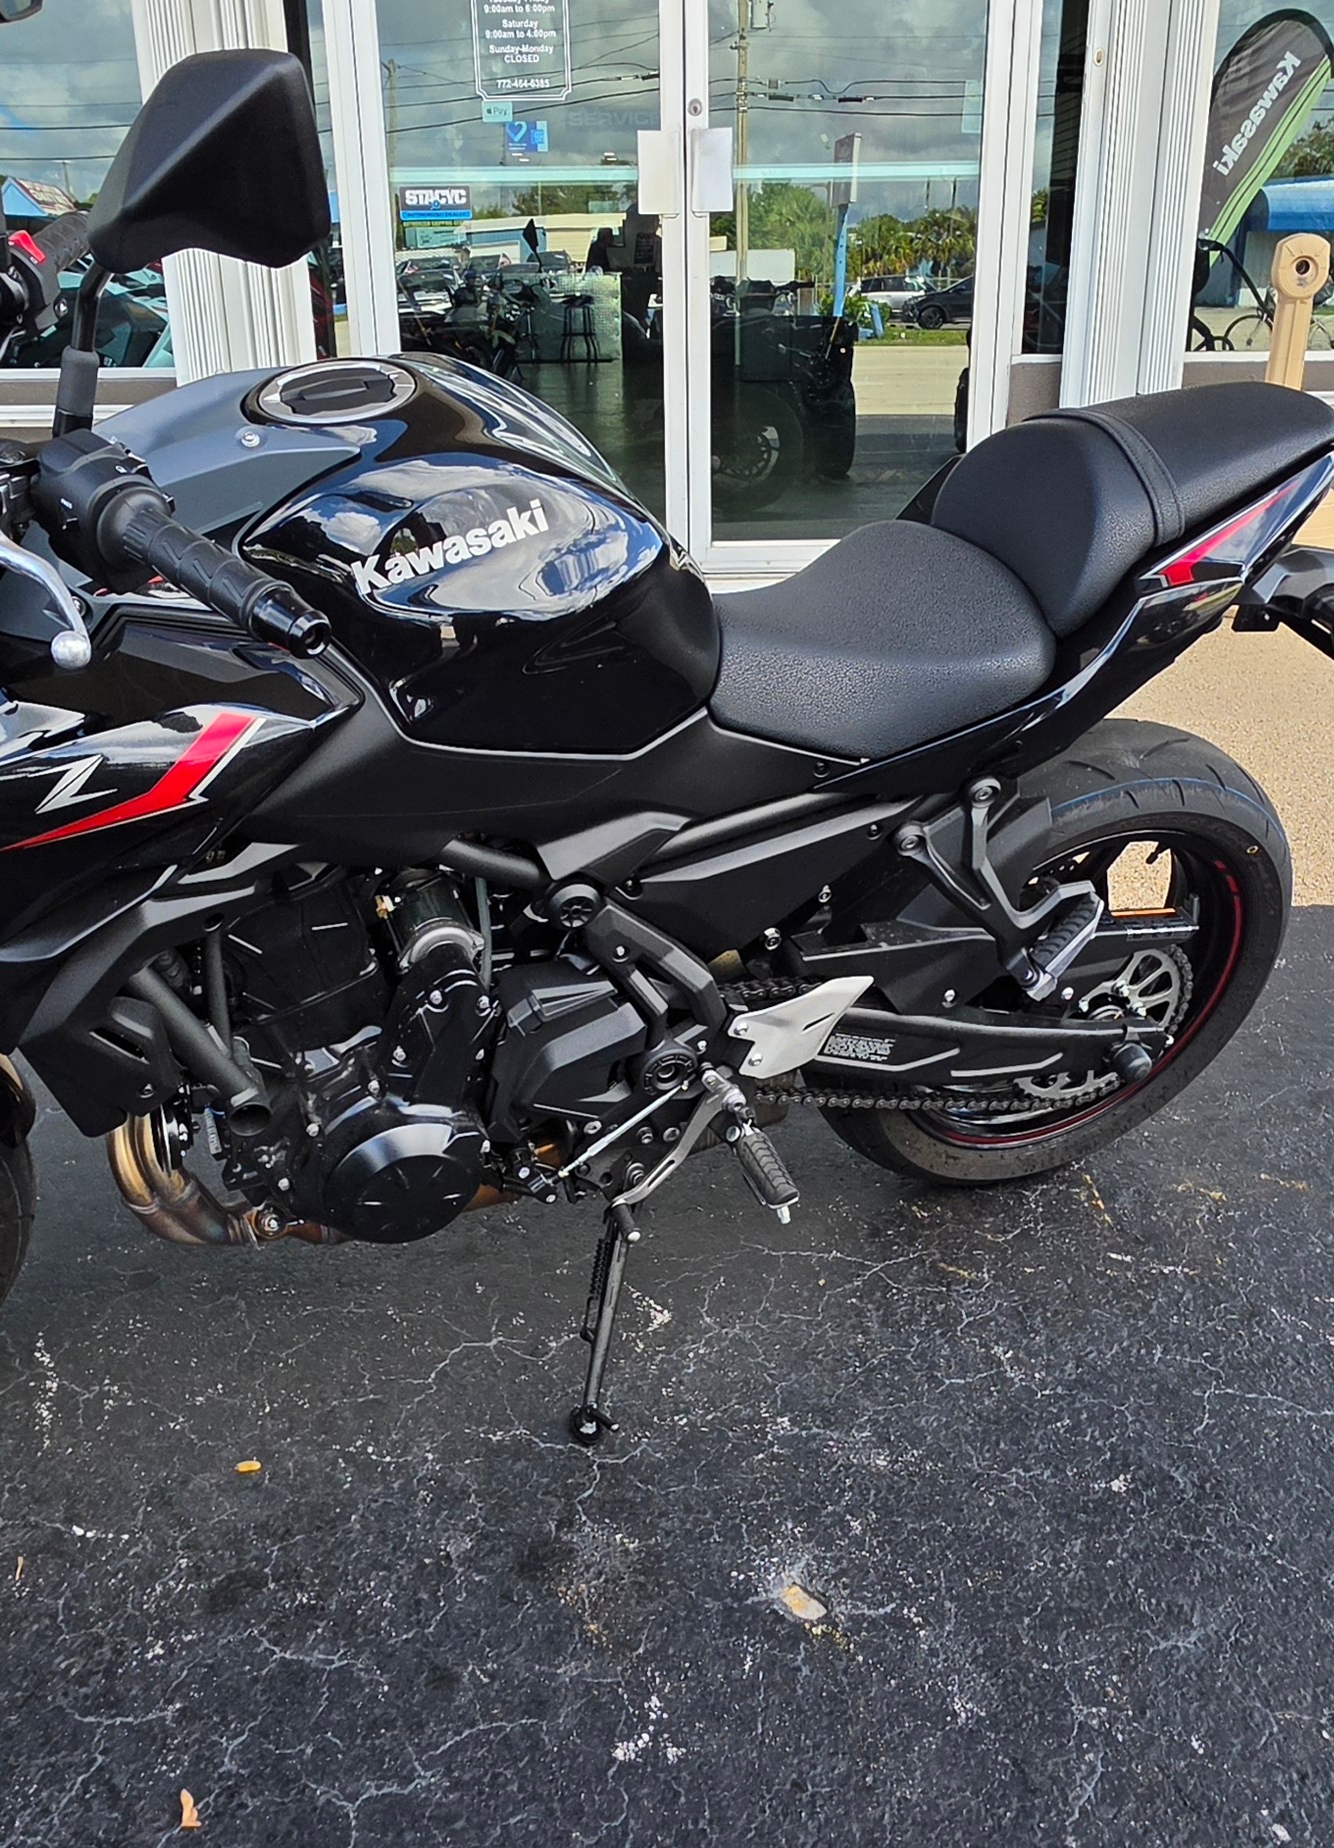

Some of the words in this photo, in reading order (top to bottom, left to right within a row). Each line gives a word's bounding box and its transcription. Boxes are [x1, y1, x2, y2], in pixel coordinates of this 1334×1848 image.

[515, 4, 524, 13] to
[501, 19, 539, 29] Saturday
[485, 29, 515, 39] 9:00am
[516, 30, 525, 39] to
[526, 29, 557, 39] 4:00pm
[489, 44, 554, 54] Sunday-Monday
[504, 54, 540, 63] CLOSED
[405, 189, 467, 205] STACYC
[350, 498, 549, 595] Kawasaki
[28, 754, 118, 815] Z
